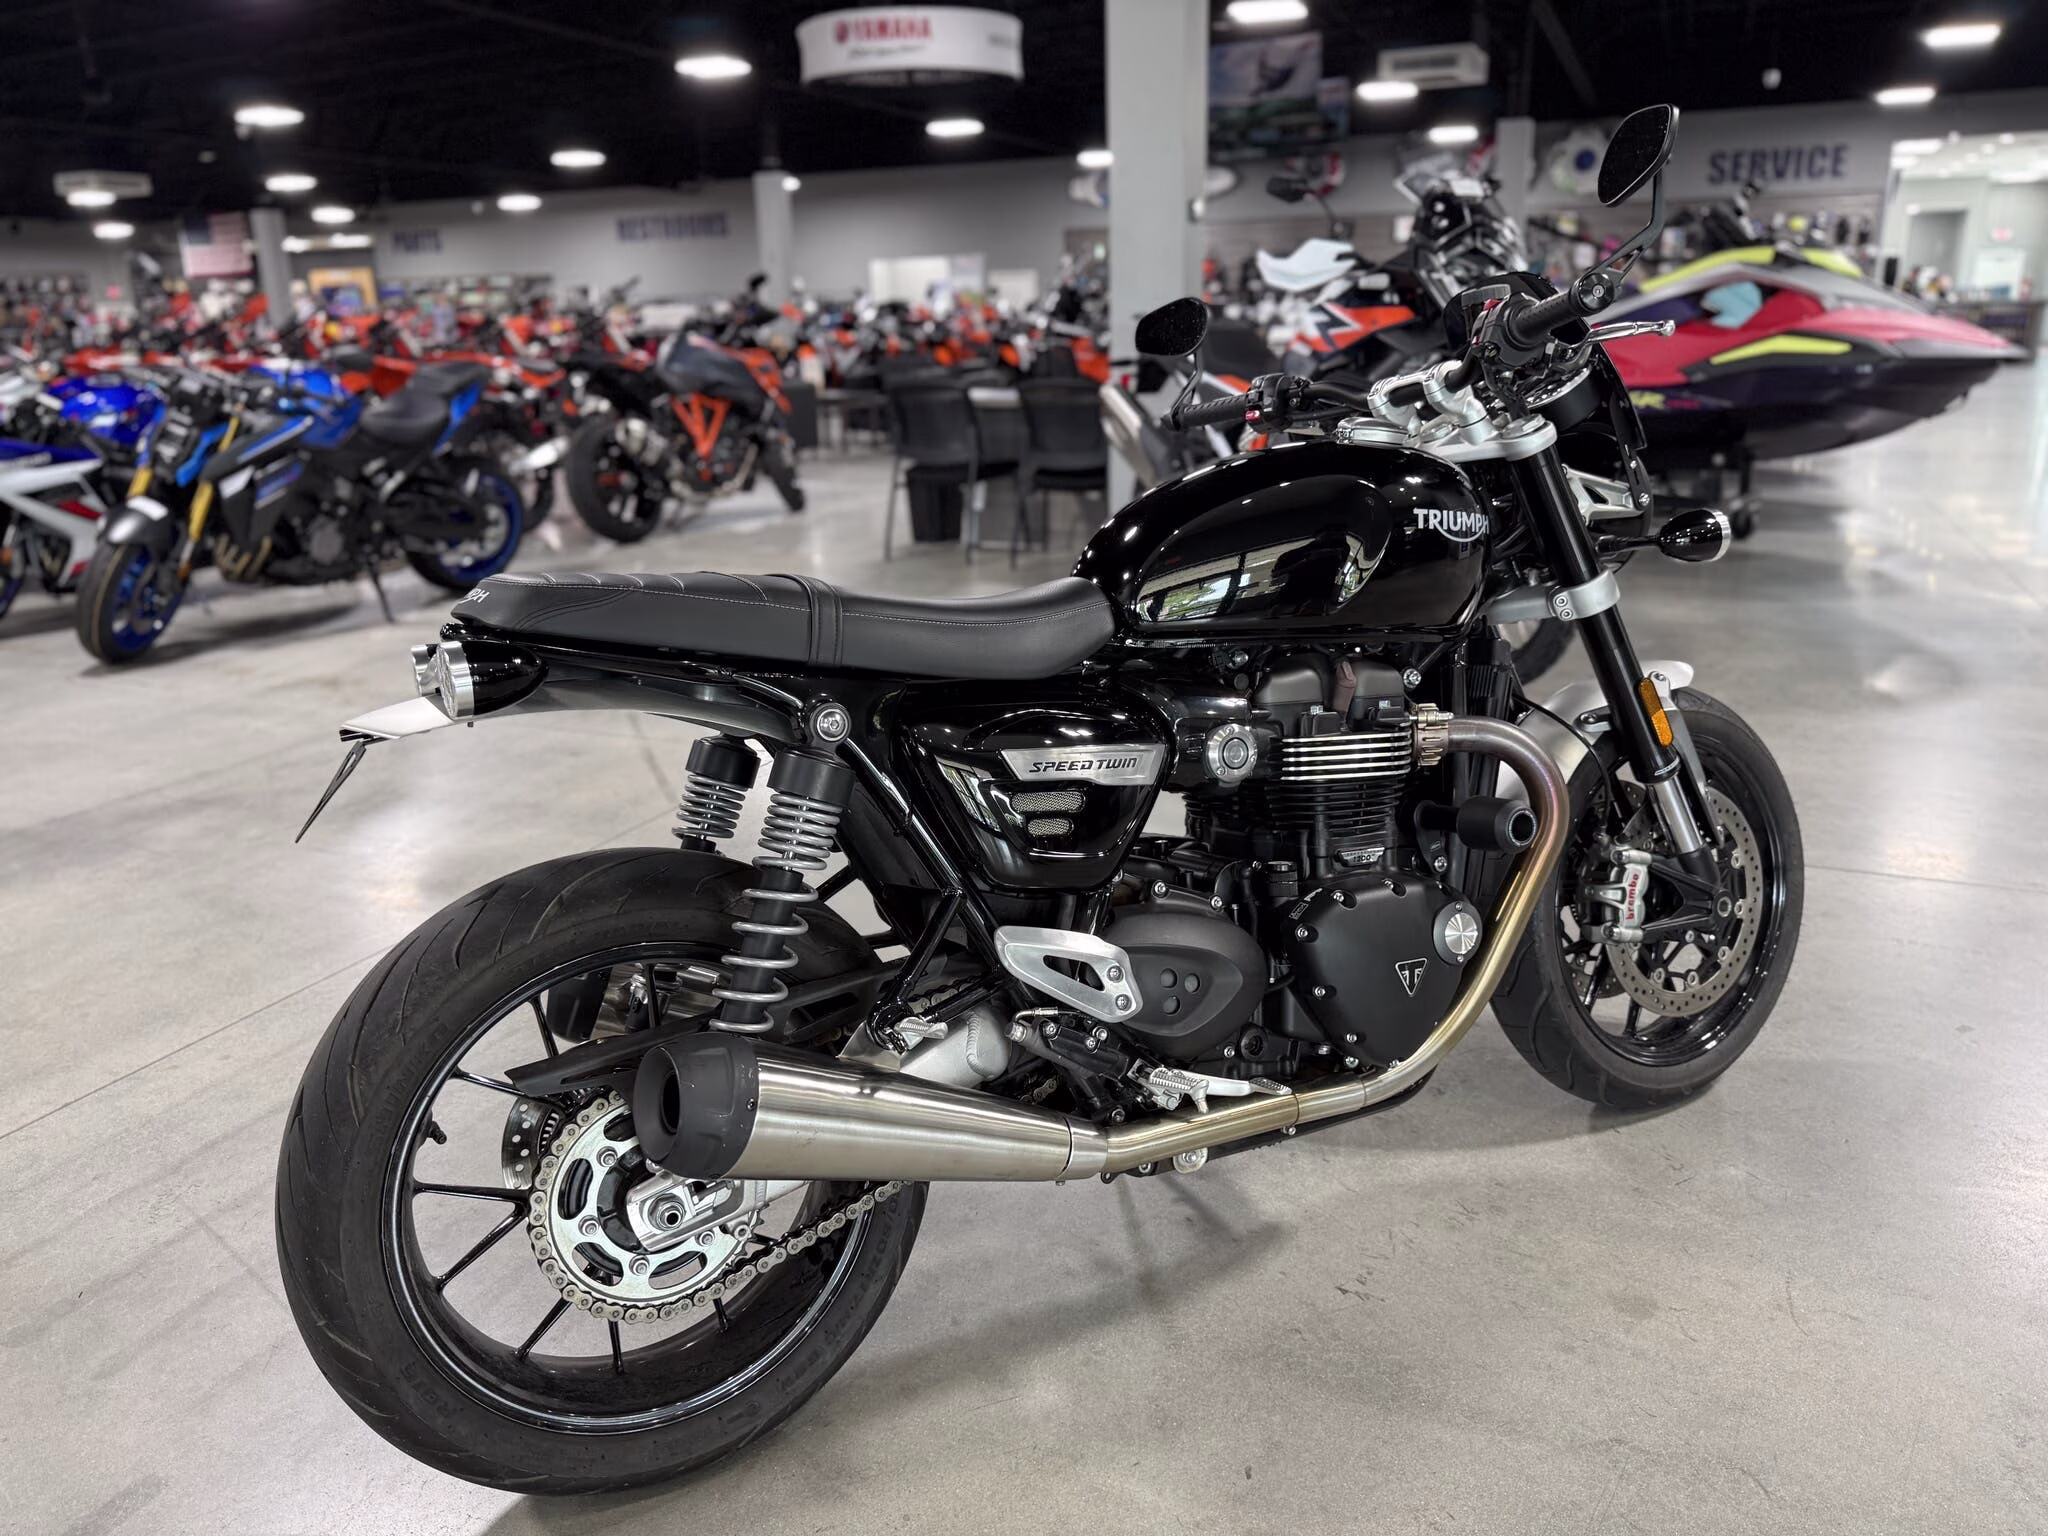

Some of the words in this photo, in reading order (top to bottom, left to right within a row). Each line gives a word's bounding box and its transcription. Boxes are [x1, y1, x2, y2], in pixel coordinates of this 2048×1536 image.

[1707, 143, 1848, 185] SERVICE
[1413, 507, 1490, 540] TRIUMPH
[1029, 760, 1094, 773] SPEED
[1096, 757, 1138, 770] TWIN
[1625, 873, 1640, 921] brembo
